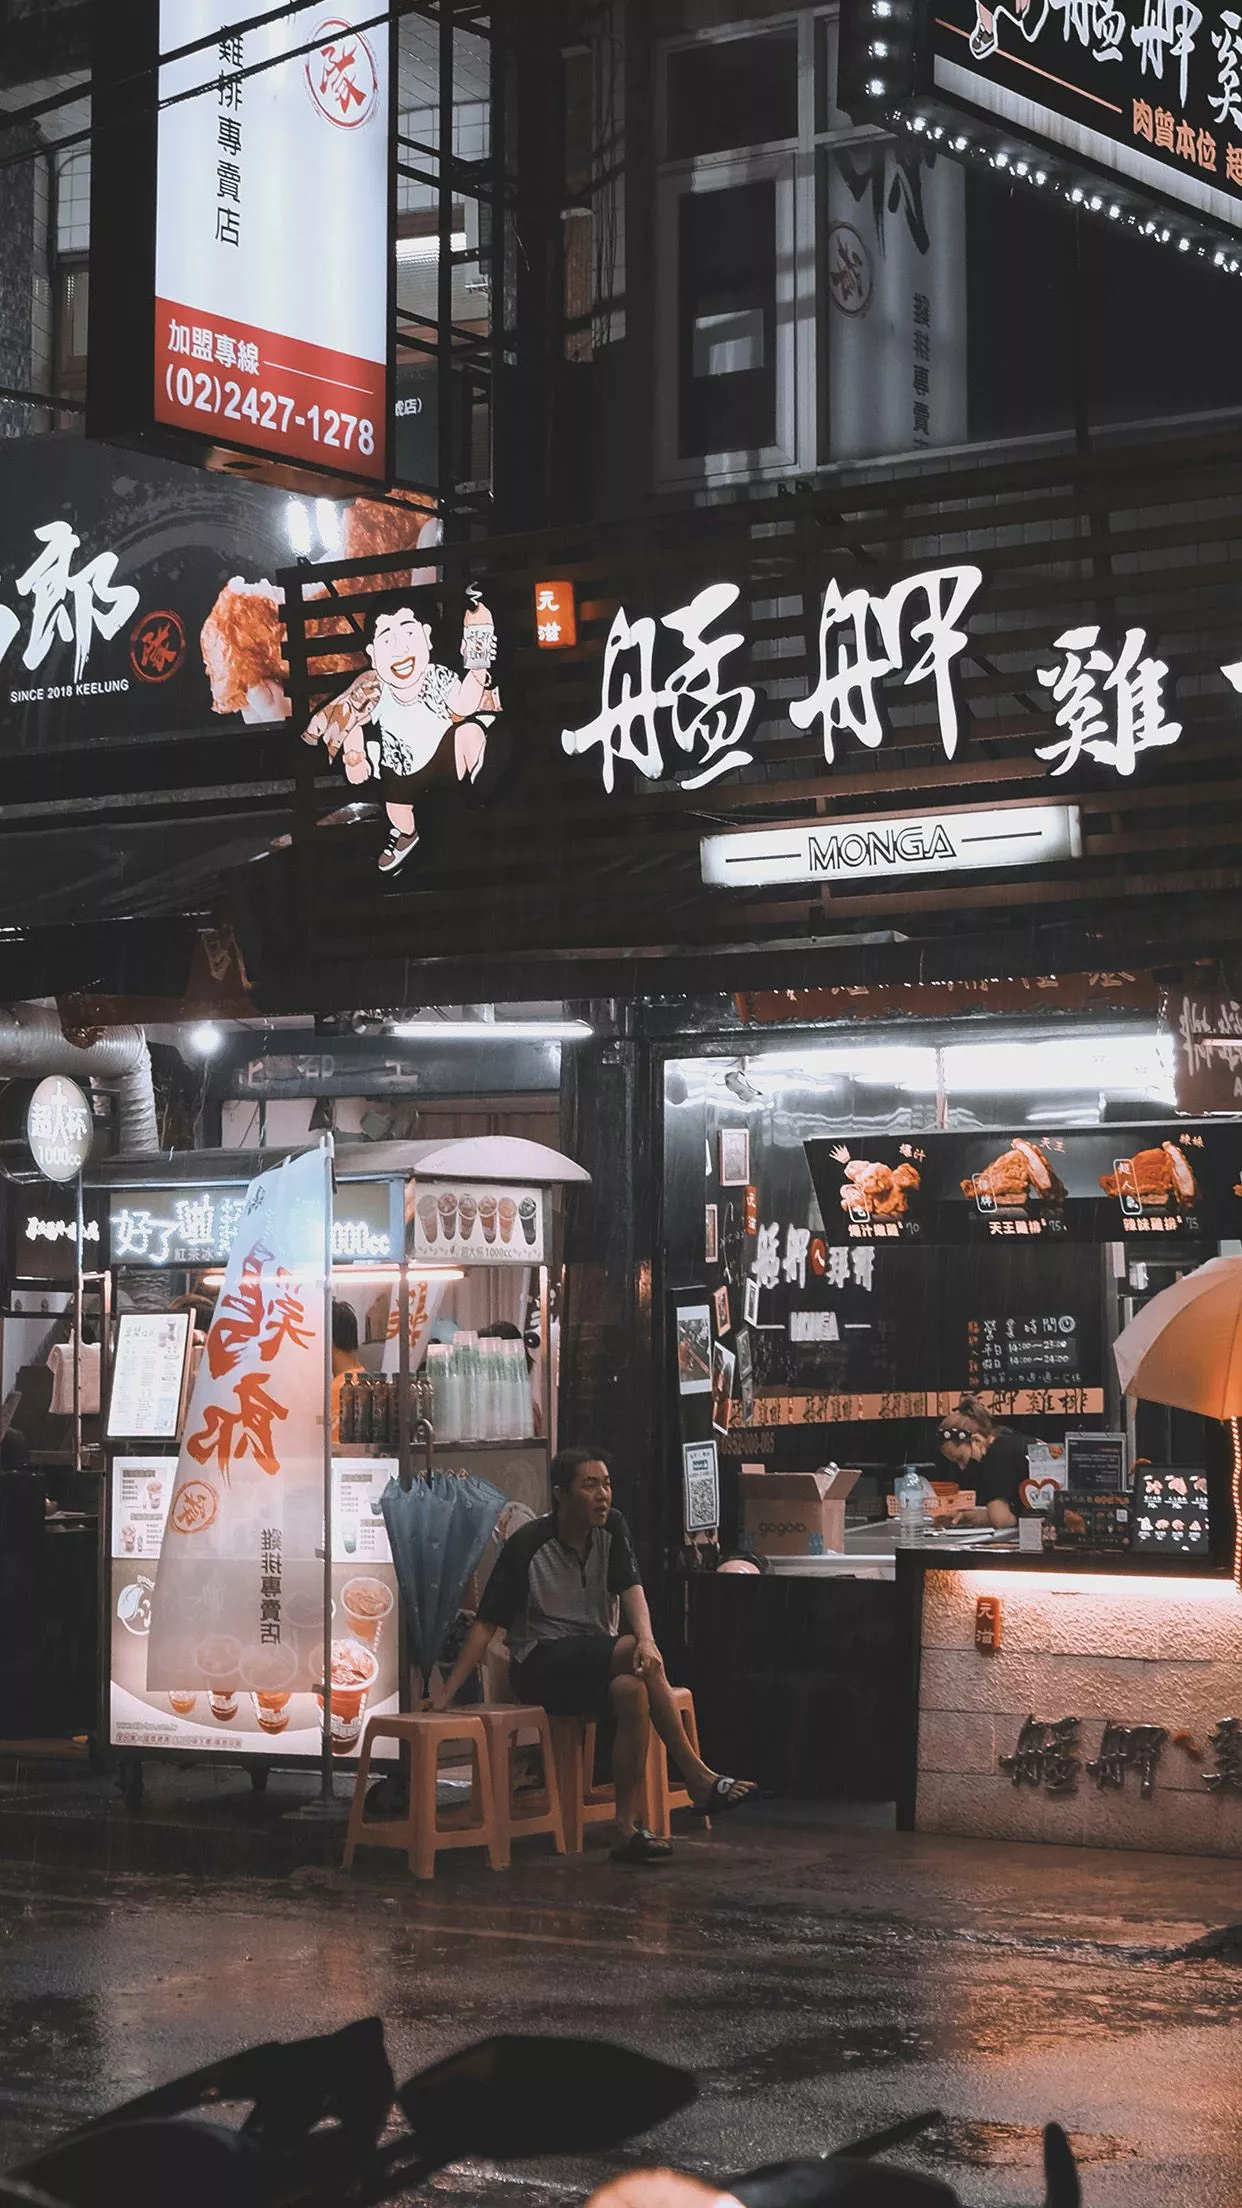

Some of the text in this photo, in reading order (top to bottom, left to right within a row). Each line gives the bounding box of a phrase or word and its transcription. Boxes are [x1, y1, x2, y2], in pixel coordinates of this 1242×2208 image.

[214, 25, 244, 248] 雞排專賣店
[1133, 98, 1217, 172] 肉質本位
[166, 317, 261, 377] 加盟專線
[165, 364, 375, 457] (02)2427-1278
[0, 521, 140, 684] 郎
[10, 678, 130, 703] SINCE 2018 KEELUNG
[562, 565, 1242, 794] 艋舺雞
[808, 823, 957, 872] MONGA
[38, 1145, 82, 1166] 1000cc
